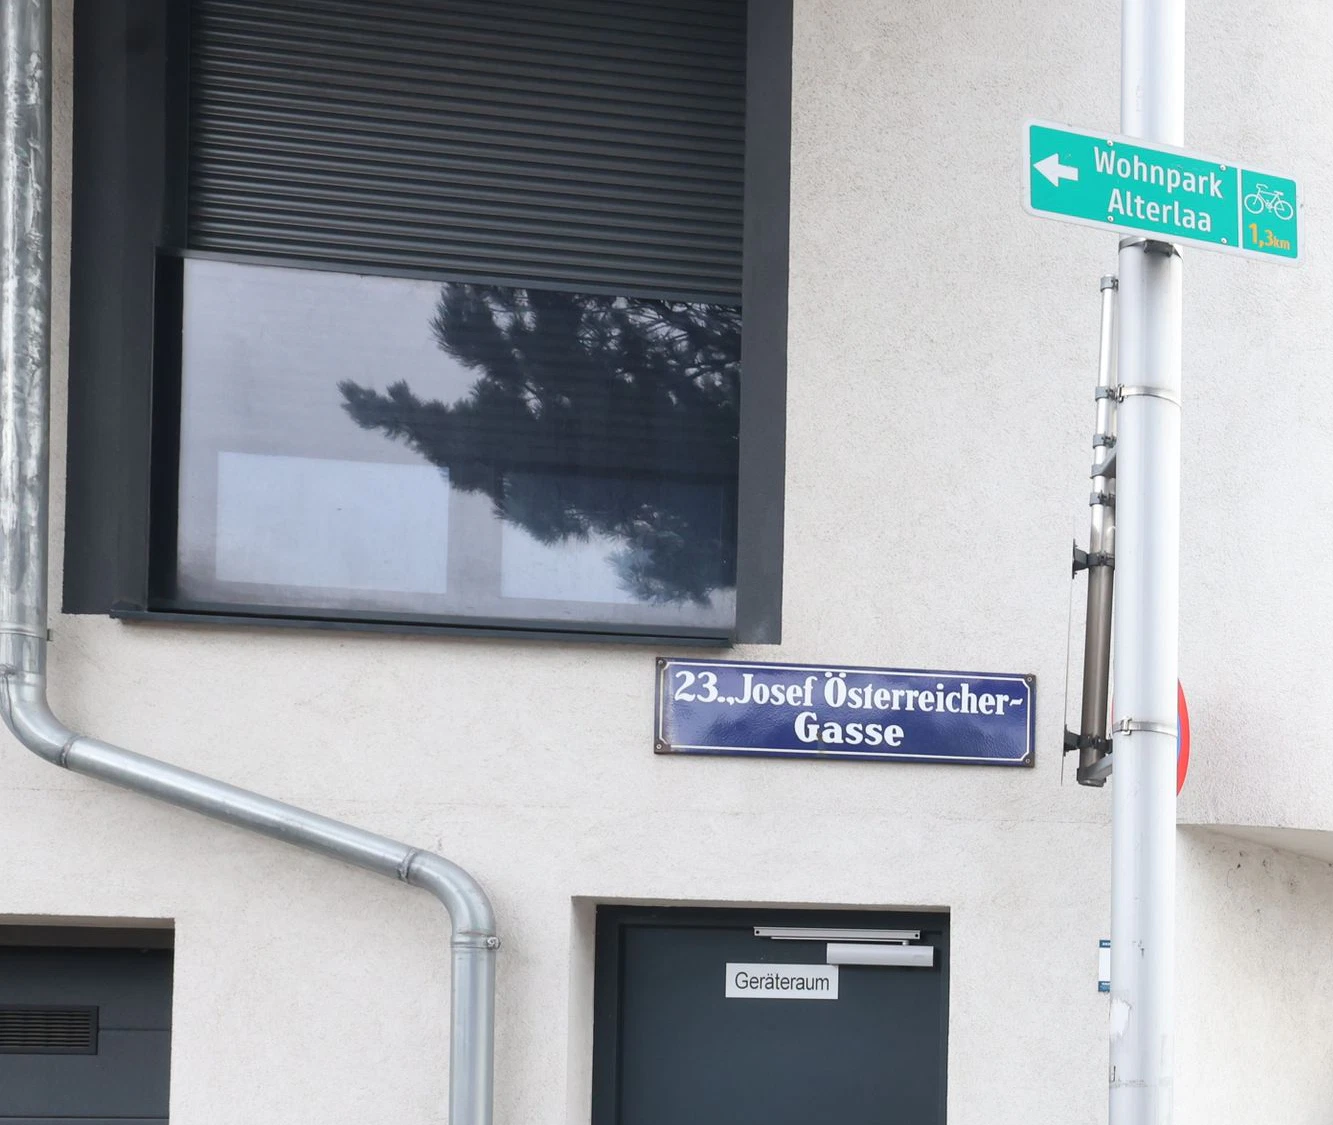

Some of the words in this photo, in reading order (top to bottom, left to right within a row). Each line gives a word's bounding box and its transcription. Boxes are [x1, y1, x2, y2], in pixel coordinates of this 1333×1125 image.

[1093, 146, 1223, 198] Wohnpark
[1107, 188, 1212, 233] Alterlaa
[734, 673, 818, 707] Josef
[824, 671, 1023, 715] Österreicher-
[793, 711, 905, 747] Gasse
[734, 971, 830, 991] Geräteraum
